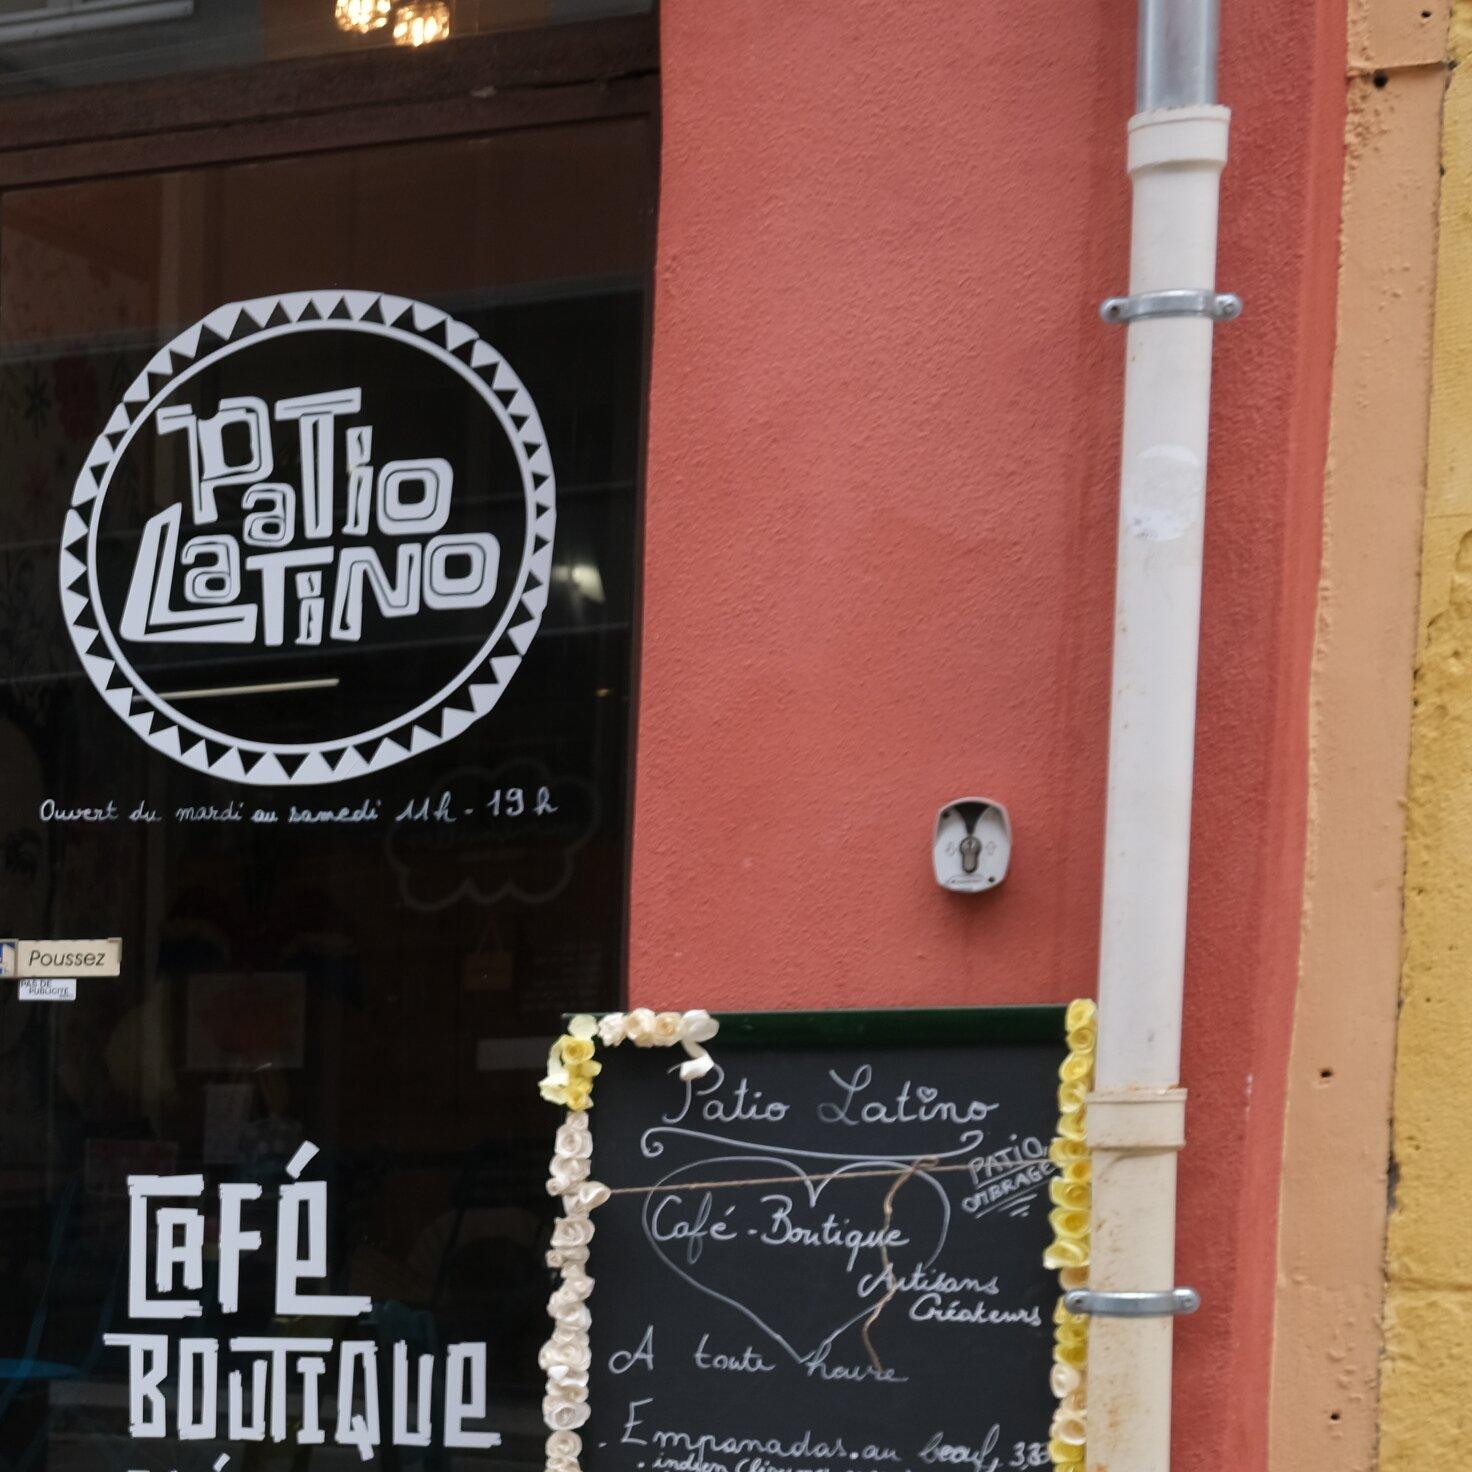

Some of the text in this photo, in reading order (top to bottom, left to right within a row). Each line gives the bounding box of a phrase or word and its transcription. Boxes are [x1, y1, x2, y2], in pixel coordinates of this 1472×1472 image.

[40, 799, 119, 821] Ouvert
[129, 800, 161, 822] du
[175, 803, 244, 822] mardi
[251, 809, 278, 823] au
[287, 799, 382, 822] samedi
[28, 950, 106, 967] Poussez
[662, 1062, 1000, 1126] Patio Latino
[609, 1325, 654, 1374] A
